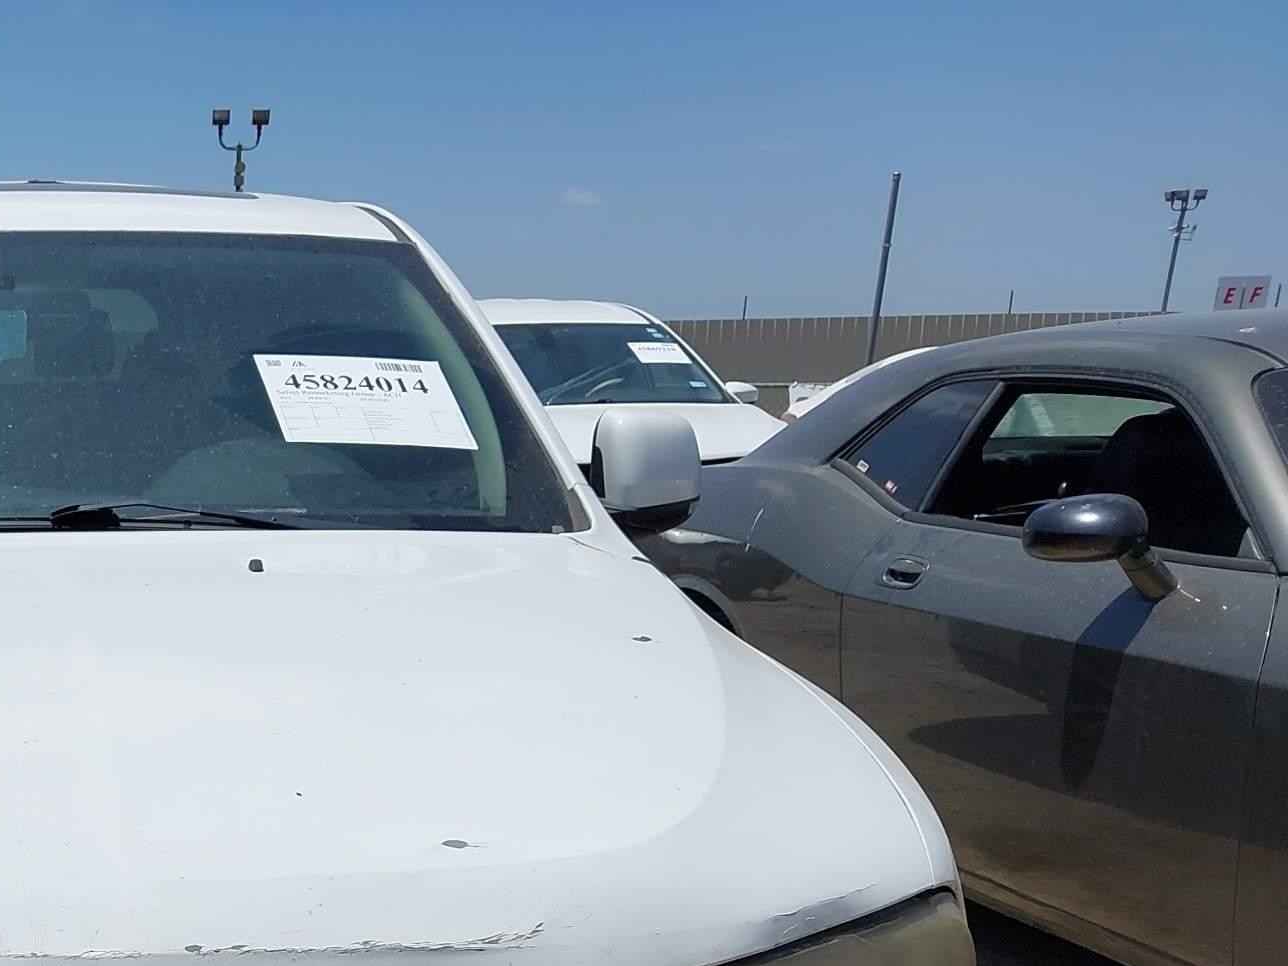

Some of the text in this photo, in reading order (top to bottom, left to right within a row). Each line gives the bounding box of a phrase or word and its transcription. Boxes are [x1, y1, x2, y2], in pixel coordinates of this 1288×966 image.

[1224, 286, 1263, 303] E F
[284, 373, 429, 394] 45824014
